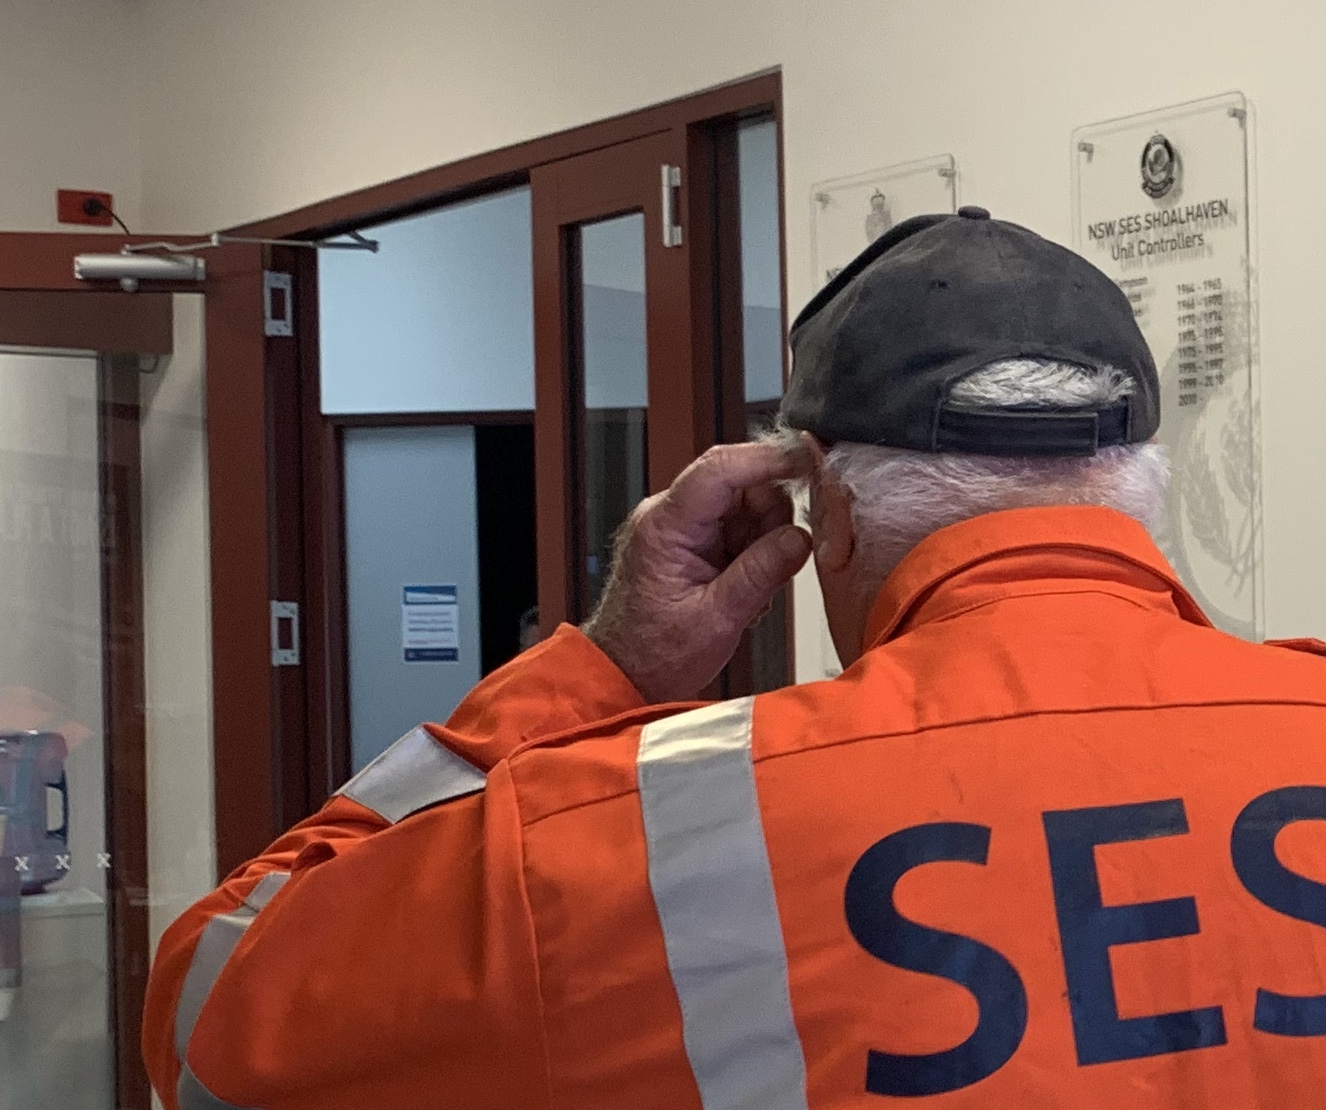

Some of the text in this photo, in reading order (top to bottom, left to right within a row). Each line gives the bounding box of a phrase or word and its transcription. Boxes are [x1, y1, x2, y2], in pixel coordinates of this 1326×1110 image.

[1088, 198, 1229, 241] NSW SES SHOALHAVEN
[1111, 232, 1205, 261] Unit Controllers
